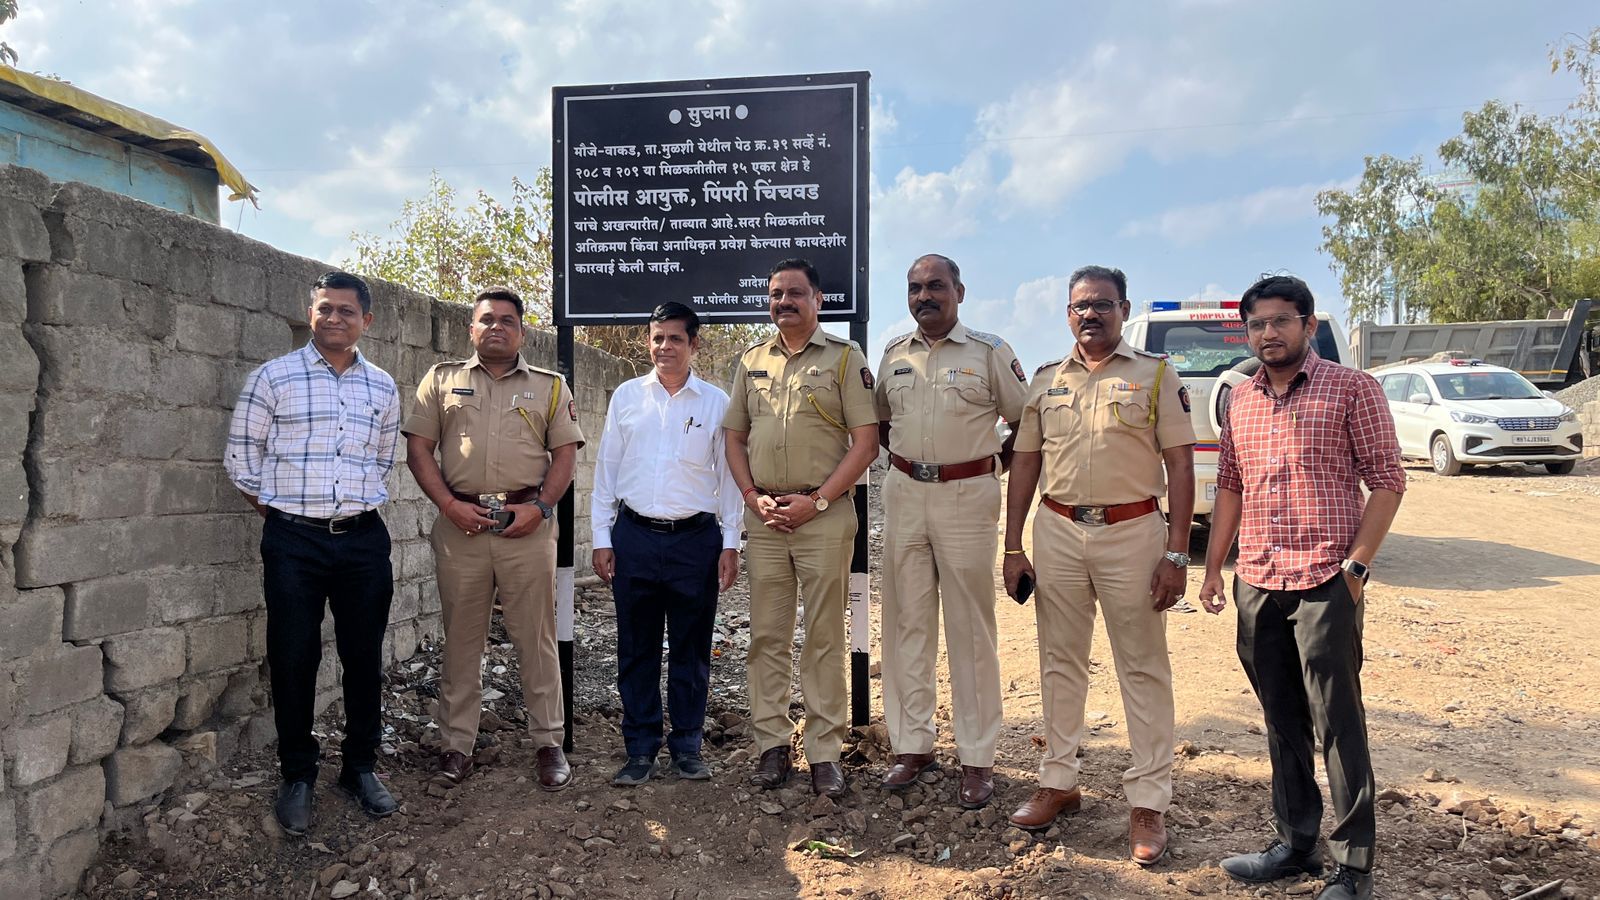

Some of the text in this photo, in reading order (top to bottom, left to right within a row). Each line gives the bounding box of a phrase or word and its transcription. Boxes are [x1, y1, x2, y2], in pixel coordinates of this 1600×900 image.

[687, 106, 730, 128] सुचना
[697, 138, 731, 153] येथील
[735, 137, 751, 152] पेठ
[576, 156, 810, 179] २०८ व २०९ या मिळकतीतील १५ एकर क्षेत्र हे
[574, 185, 629, 207] पोलीस
[702, 181, 748, 203] पिंपरी
[753, 179, 819, 202] चिंचवड
[574, 217, 598, 232] यांचे
[764, 212, 825, 228] मिळकतीवर
[575, 238, 627, 253] अतिक्रमण
[630, 237, 658, 252] किंवा
[719, 235, 746, 251] प्रवेश
[750, 235, 791, 249] केल्यास
[794, 232, 846, 249] कायदेशीर
[575, 259, 615, 277] कारवाई
[618, 259, 644, 273] केली
[739, 275, 768, 289] आदेशा
[1189, 312, 1224, 320] PIMPRI
